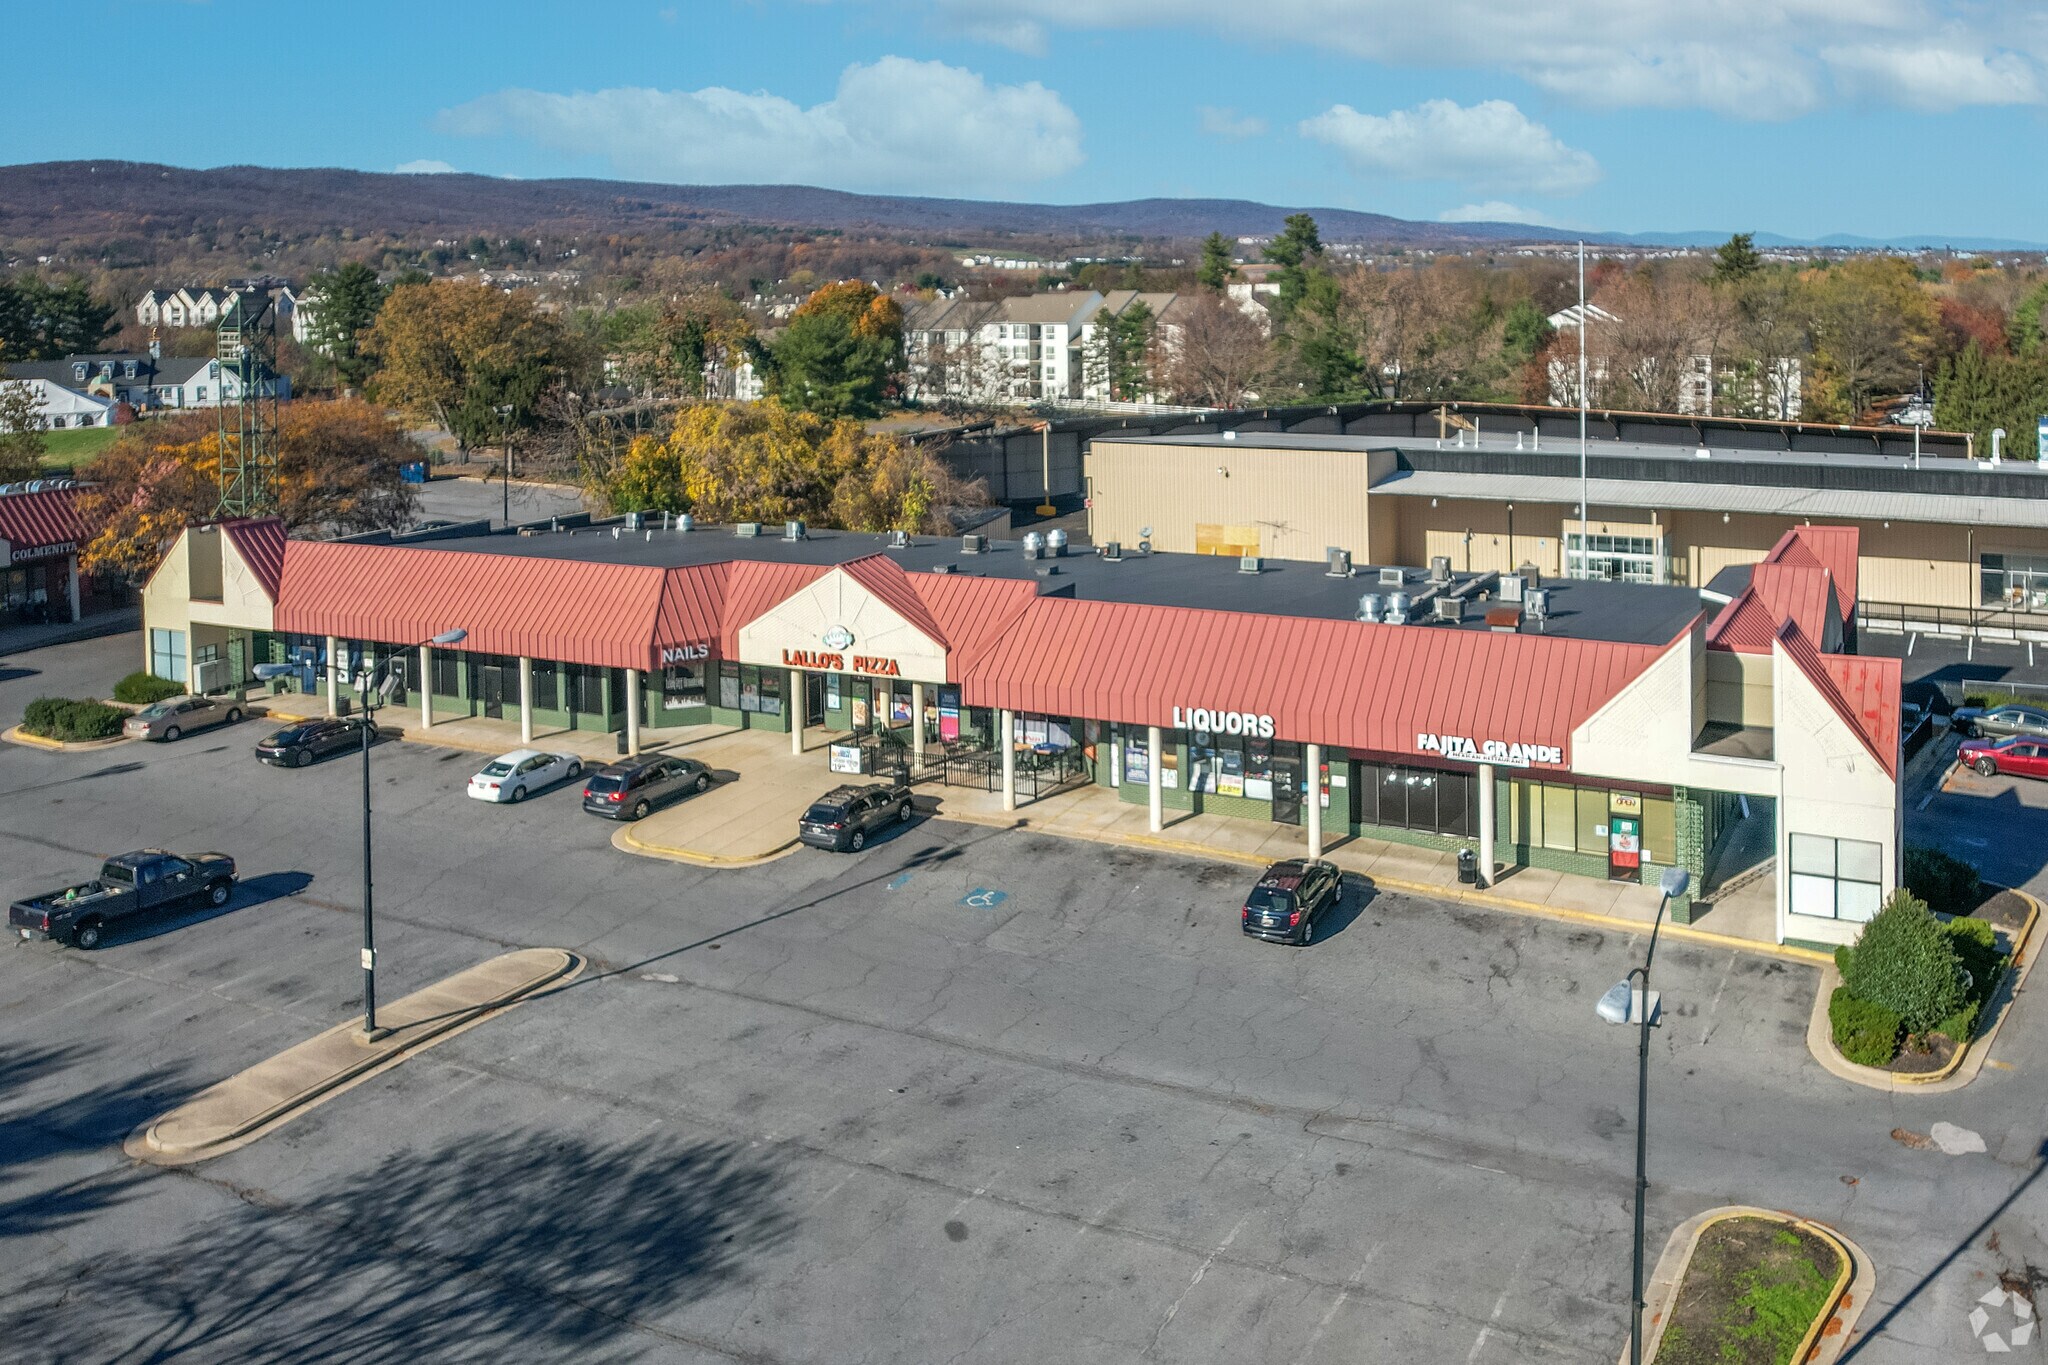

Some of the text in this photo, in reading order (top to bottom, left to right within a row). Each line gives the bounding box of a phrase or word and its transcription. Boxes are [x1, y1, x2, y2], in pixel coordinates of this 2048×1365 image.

[12, 541, 77, 561] COLMENITA
[663, 643, 709, 663] NAILS
[782, 648, 901, 676] LALLO'S PIZZA
[1173, 706, 1275, 738] LIQUORS
[1417, 733, 1563, 764] FAJITA GRANDE
[1616, 797, 1637, 806] OPEN
